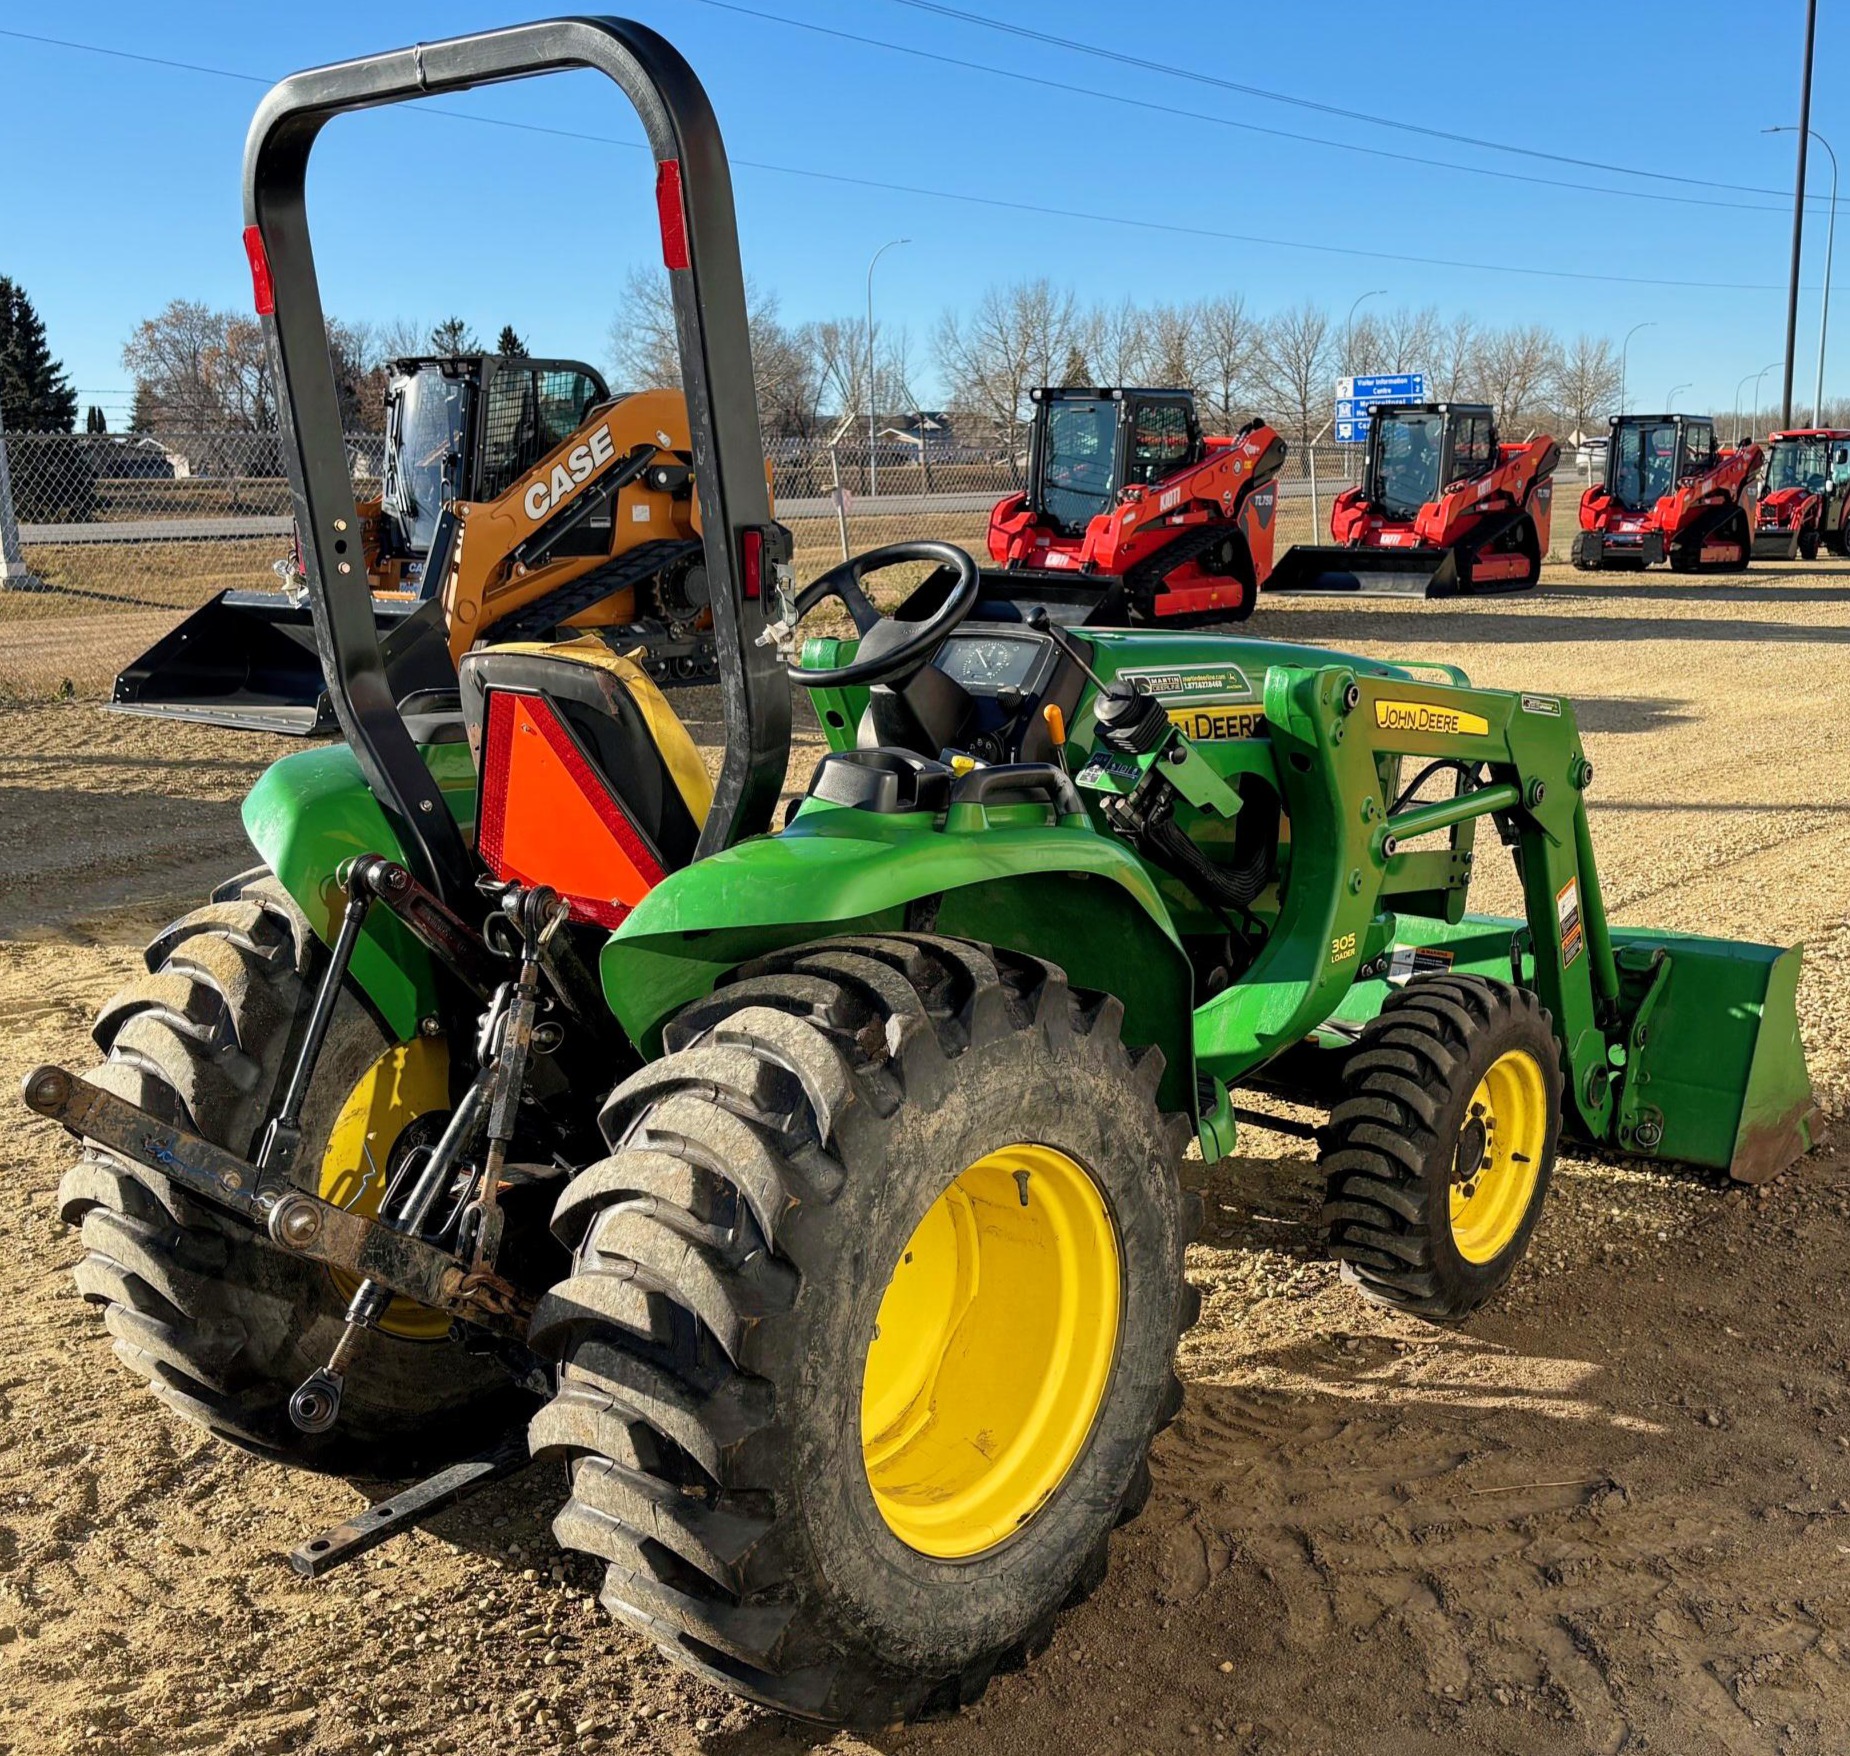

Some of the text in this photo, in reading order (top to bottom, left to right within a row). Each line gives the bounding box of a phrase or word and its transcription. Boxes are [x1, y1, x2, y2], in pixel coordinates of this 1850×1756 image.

[1373, 387, 1392, 395] Centre
[524, 423, 615, 520] CASE
[1160, 486, 1181, 511] KIOTI
[1380, 705, 1459, 732] JOHN DEERE
[1331, 932, 1356, 954] 305
[1331, 947, 1356, 964] LOADER
